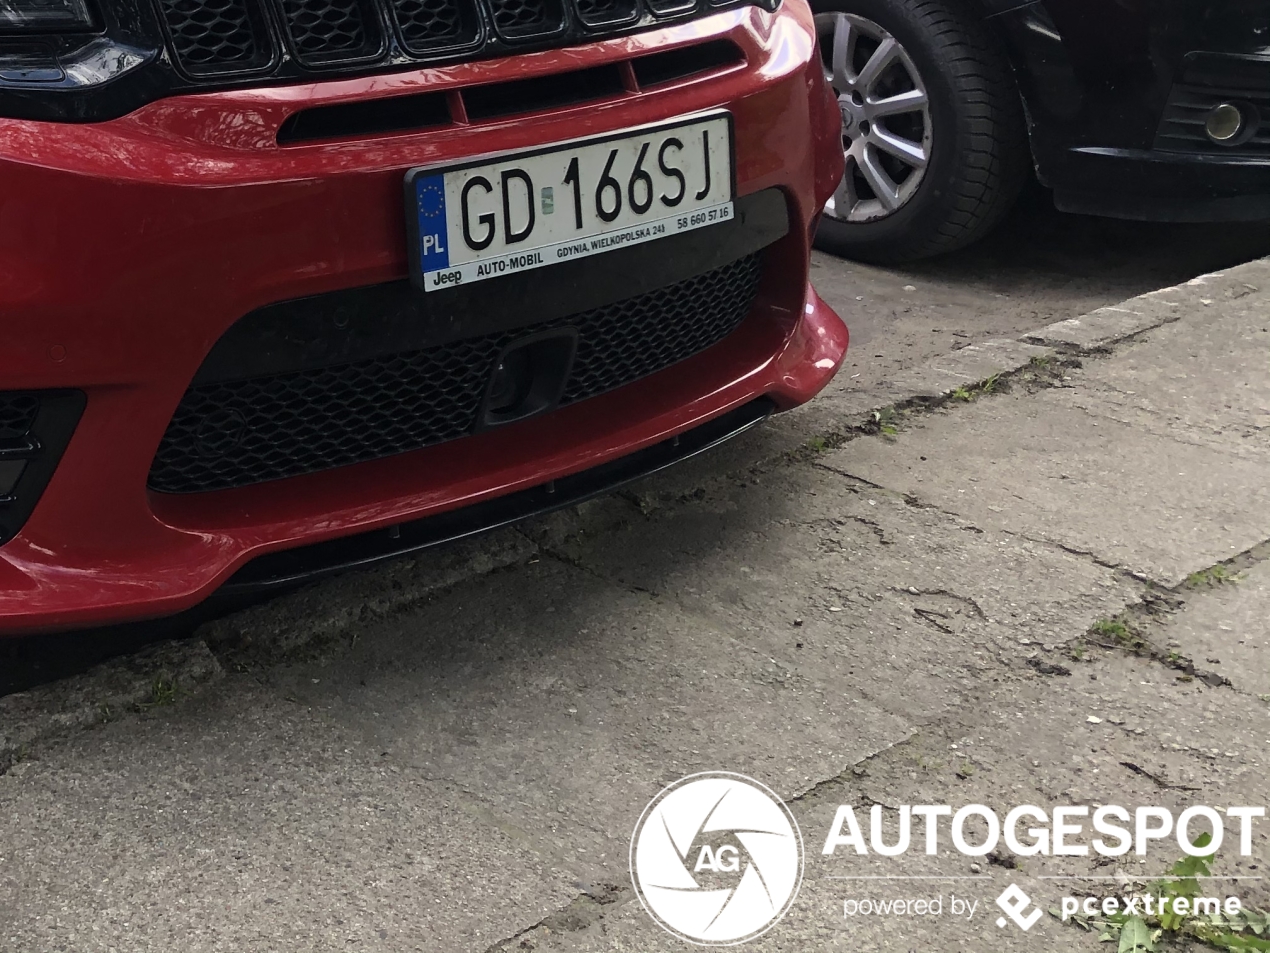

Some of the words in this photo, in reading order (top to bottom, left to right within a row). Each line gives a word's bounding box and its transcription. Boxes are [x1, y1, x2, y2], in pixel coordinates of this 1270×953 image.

[460, 167, 536, 251] GD
[561, 129, 711, 230] 166SJ
[422, 233, 445, 256] PL
[433, 270, 462, 286] Jeep
[477, 252, 544, 277] AUTO-MOBIL
[590, 227, 651, 251] WIELKOPOLSKA
[677, 217, 688, 229] 58
[690, 212, 707, 226] 660
[708, 209, 718, 221] 57
[719, 206, 729, 218] 16
